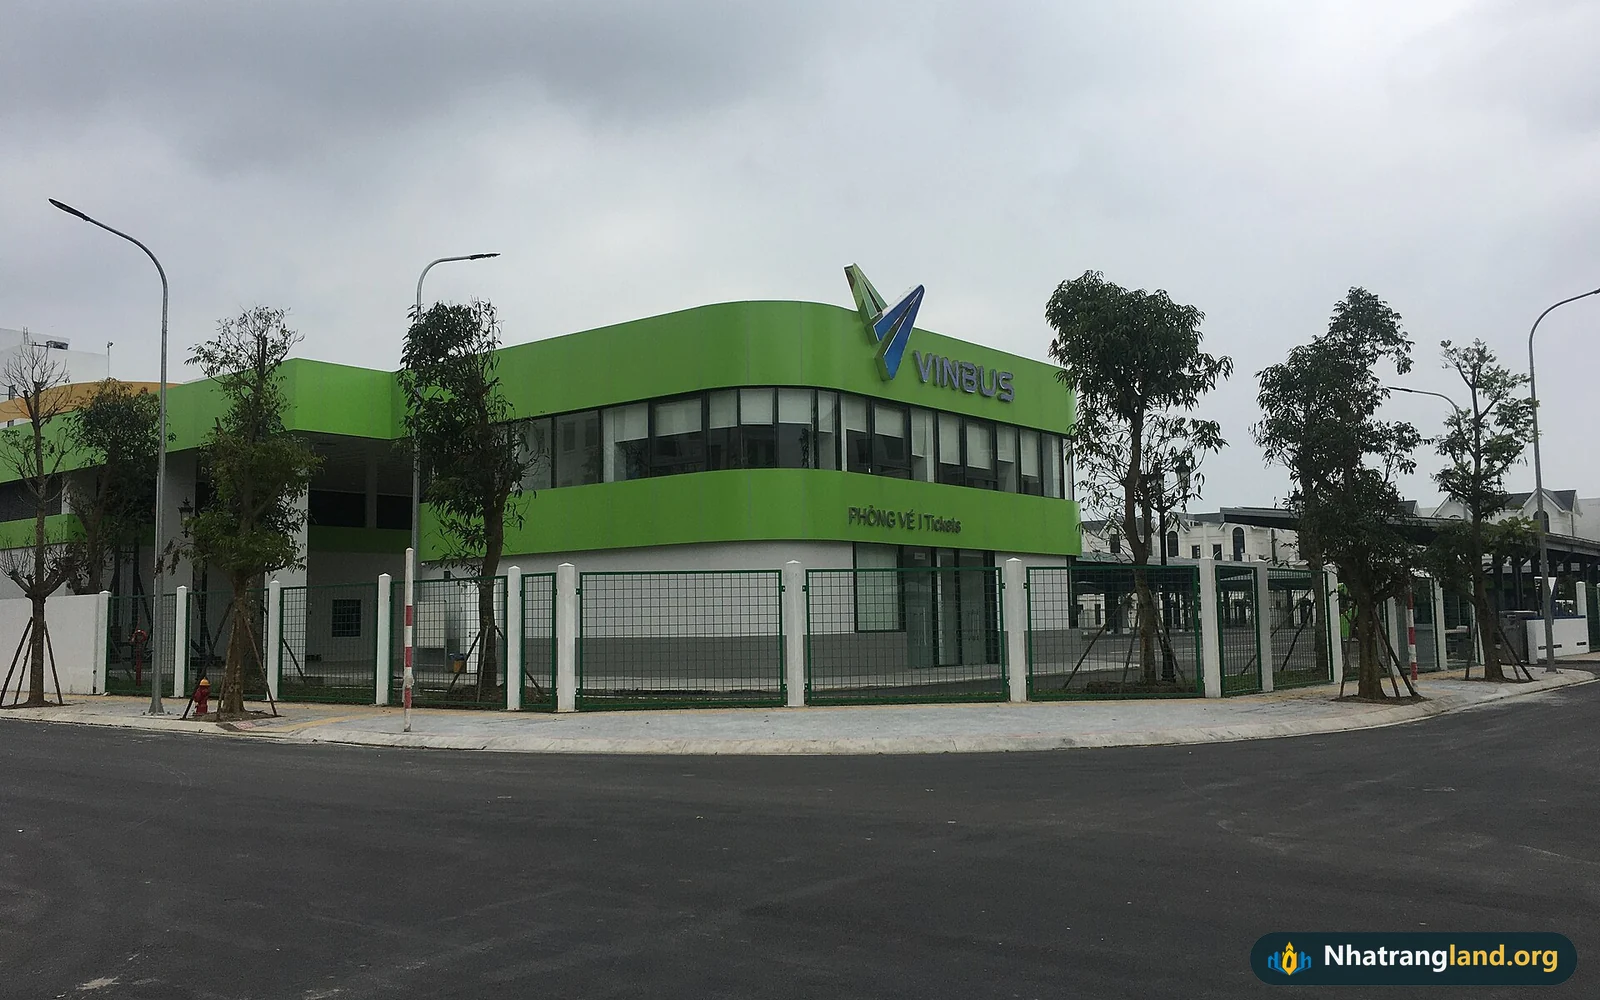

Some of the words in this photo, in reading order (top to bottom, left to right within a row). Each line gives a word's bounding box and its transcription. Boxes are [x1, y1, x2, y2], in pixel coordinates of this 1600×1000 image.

[912, 349, 1015, 402] VINBUS
[897, 509, 916, 530] VÉ
[924, 513, 962, 534] Tickets
